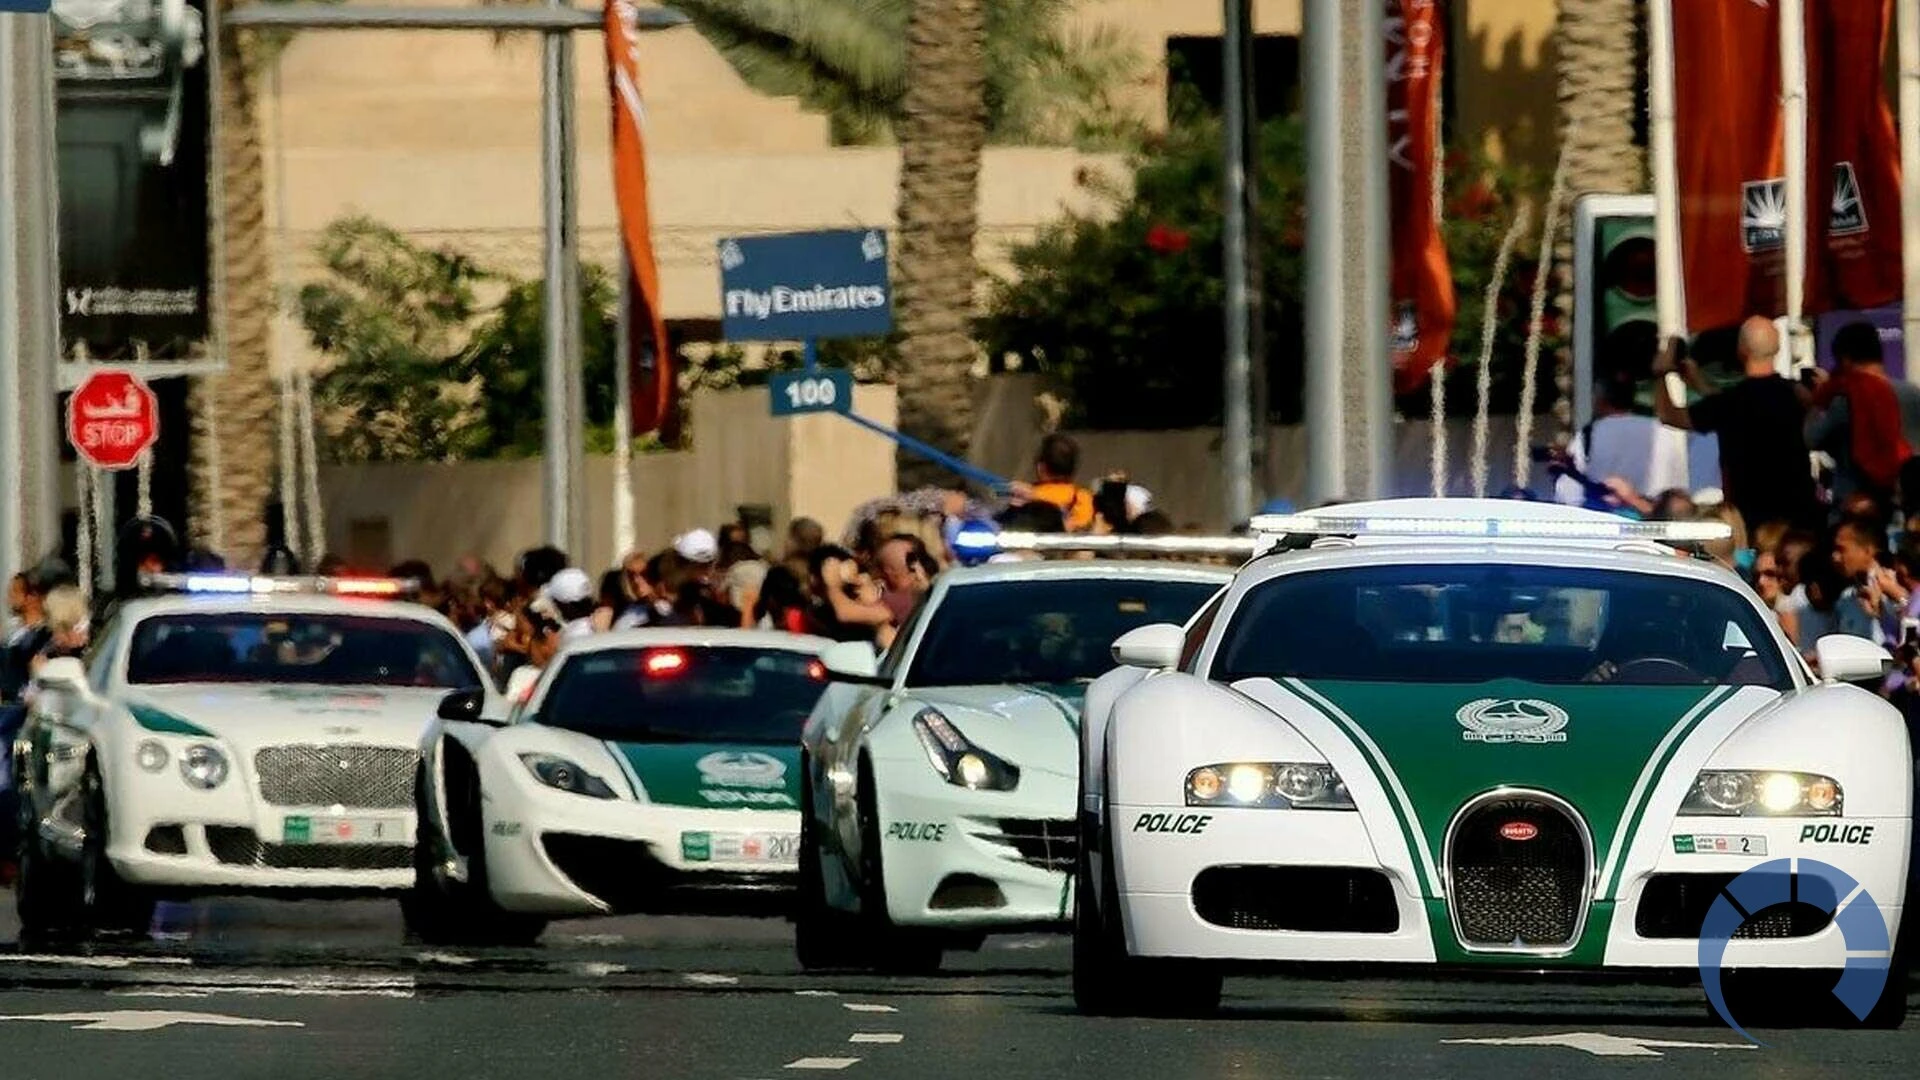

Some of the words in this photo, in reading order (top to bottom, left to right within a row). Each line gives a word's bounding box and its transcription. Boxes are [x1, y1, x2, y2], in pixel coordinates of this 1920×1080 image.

[726, 289, 771, 319] Fly
[772, 284, 885, 313] Emirates
[785, 378, 836, 408] 100
[83, 421, 143, 448] STOP
[885, 822, 947, 841] POLICE
[1133, 813, 1213, 833] POLICE
[1799, 824, 1874, 844] POLICE
[1741, 837, 1751, 853] 2
